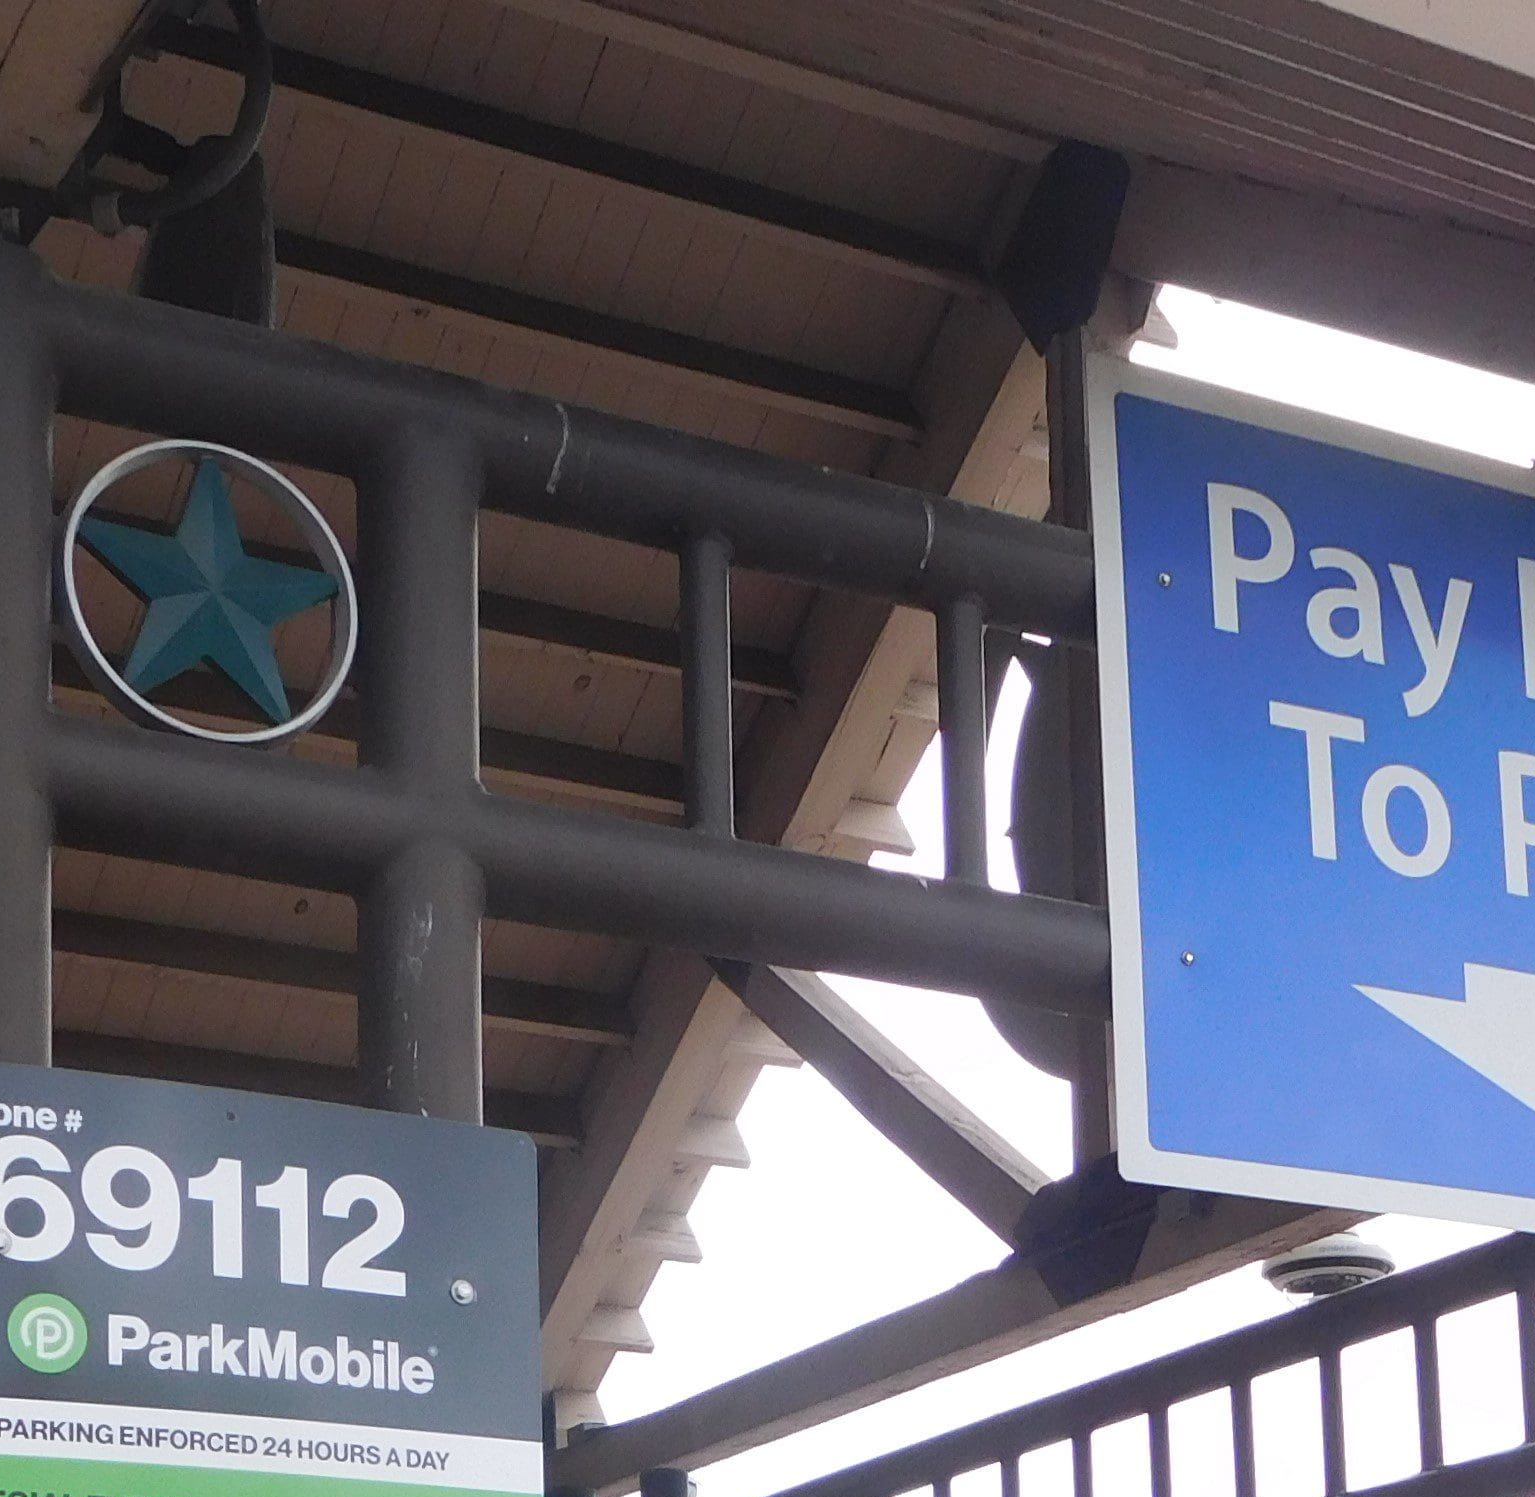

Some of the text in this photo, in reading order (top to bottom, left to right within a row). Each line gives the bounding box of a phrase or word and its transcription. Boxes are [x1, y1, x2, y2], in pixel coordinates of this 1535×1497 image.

[1206, 481, 1474, 717] Pay
[1269, 700, 1452, 878] To
[64, 1109, 83, 1133] #
[107, 1313, 435, 1394] ParkMobile
[119, 1425, 258, 1456] ENFORCED
[262, 1436, 293, 1458] 24
[297, 1439, 381, 1466] HOURS
[385, 1446, 402, 1465] A
[406, 1448, 450, 1471] DAY
